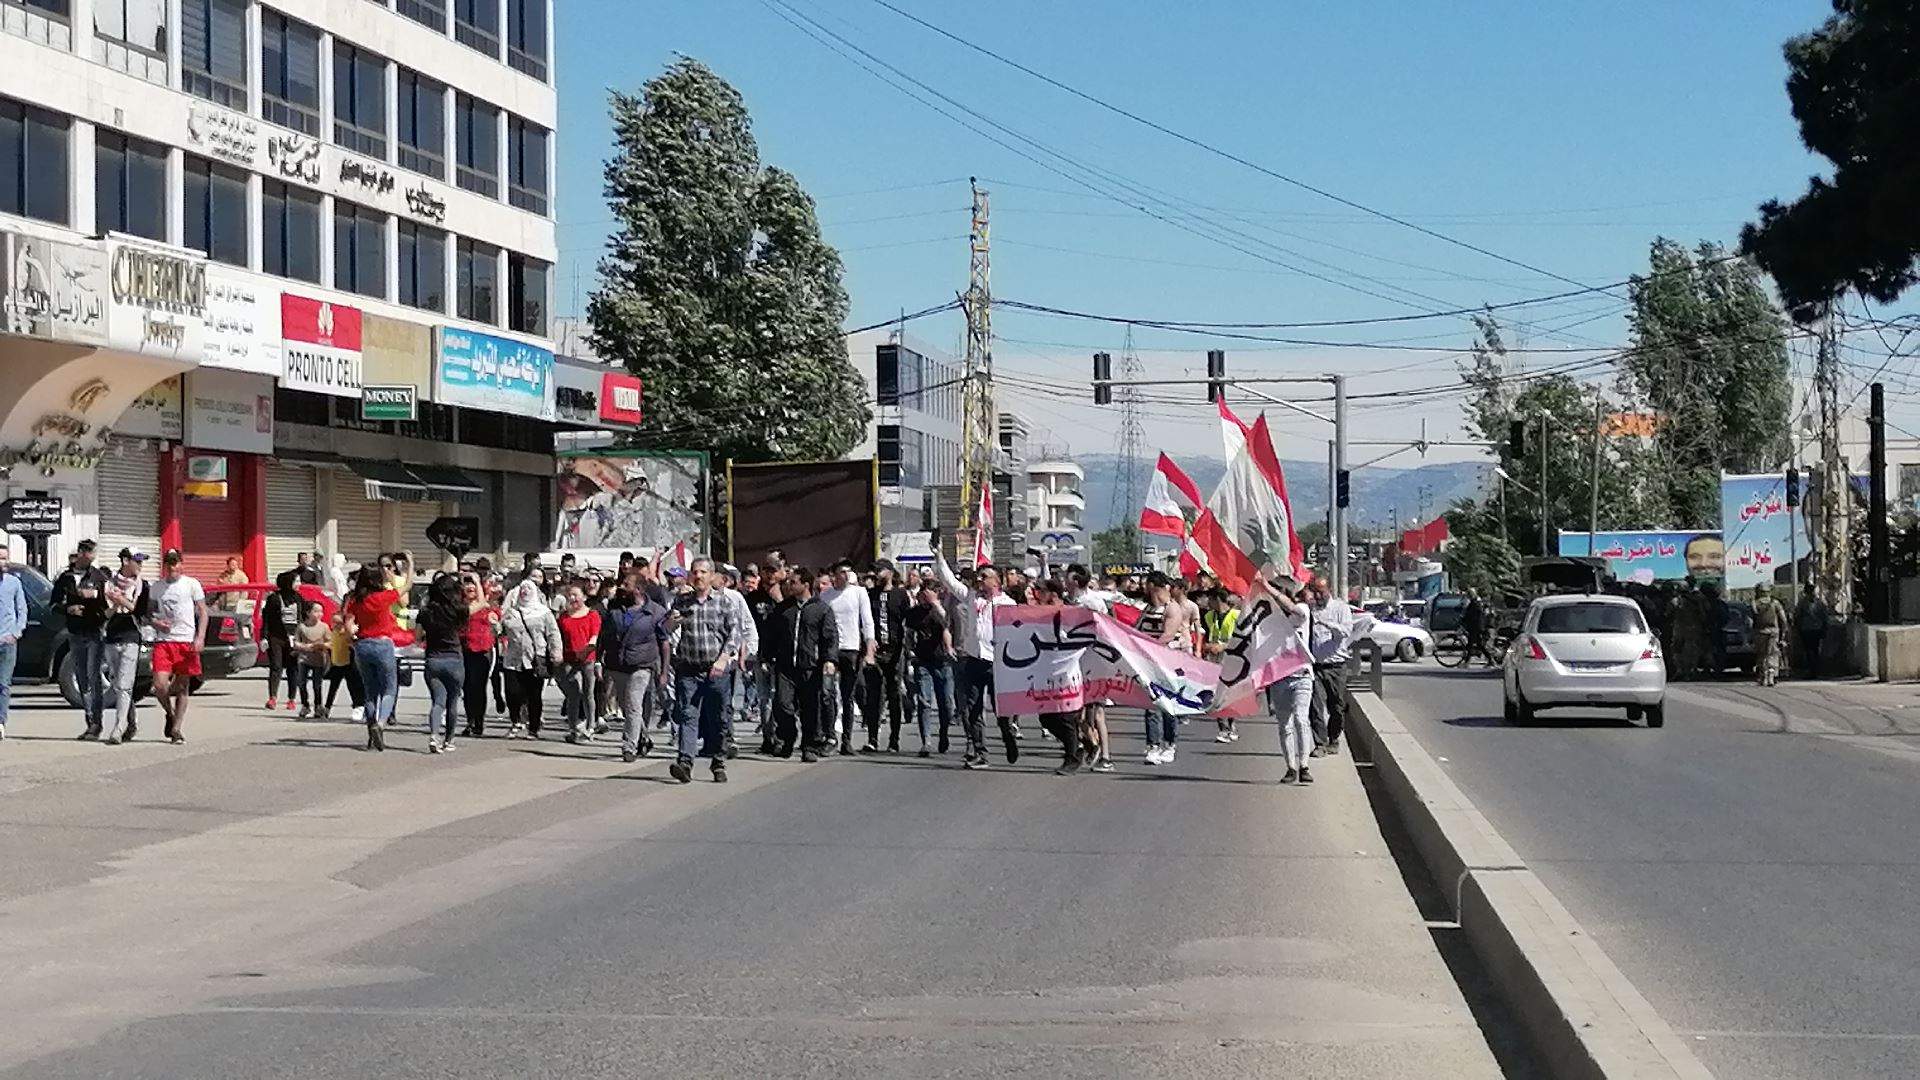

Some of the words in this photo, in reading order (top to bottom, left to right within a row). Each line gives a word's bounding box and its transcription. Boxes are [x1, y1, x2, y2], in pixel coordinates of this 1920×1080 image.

[52, 290, 104, 326] البرازيل
[288, 350, 333, 385] PRONTO
[337, 358, 361, 388] CELL
[365, 390, 411, 404] MONEY
[1658, 538, 1677, 558] ما
